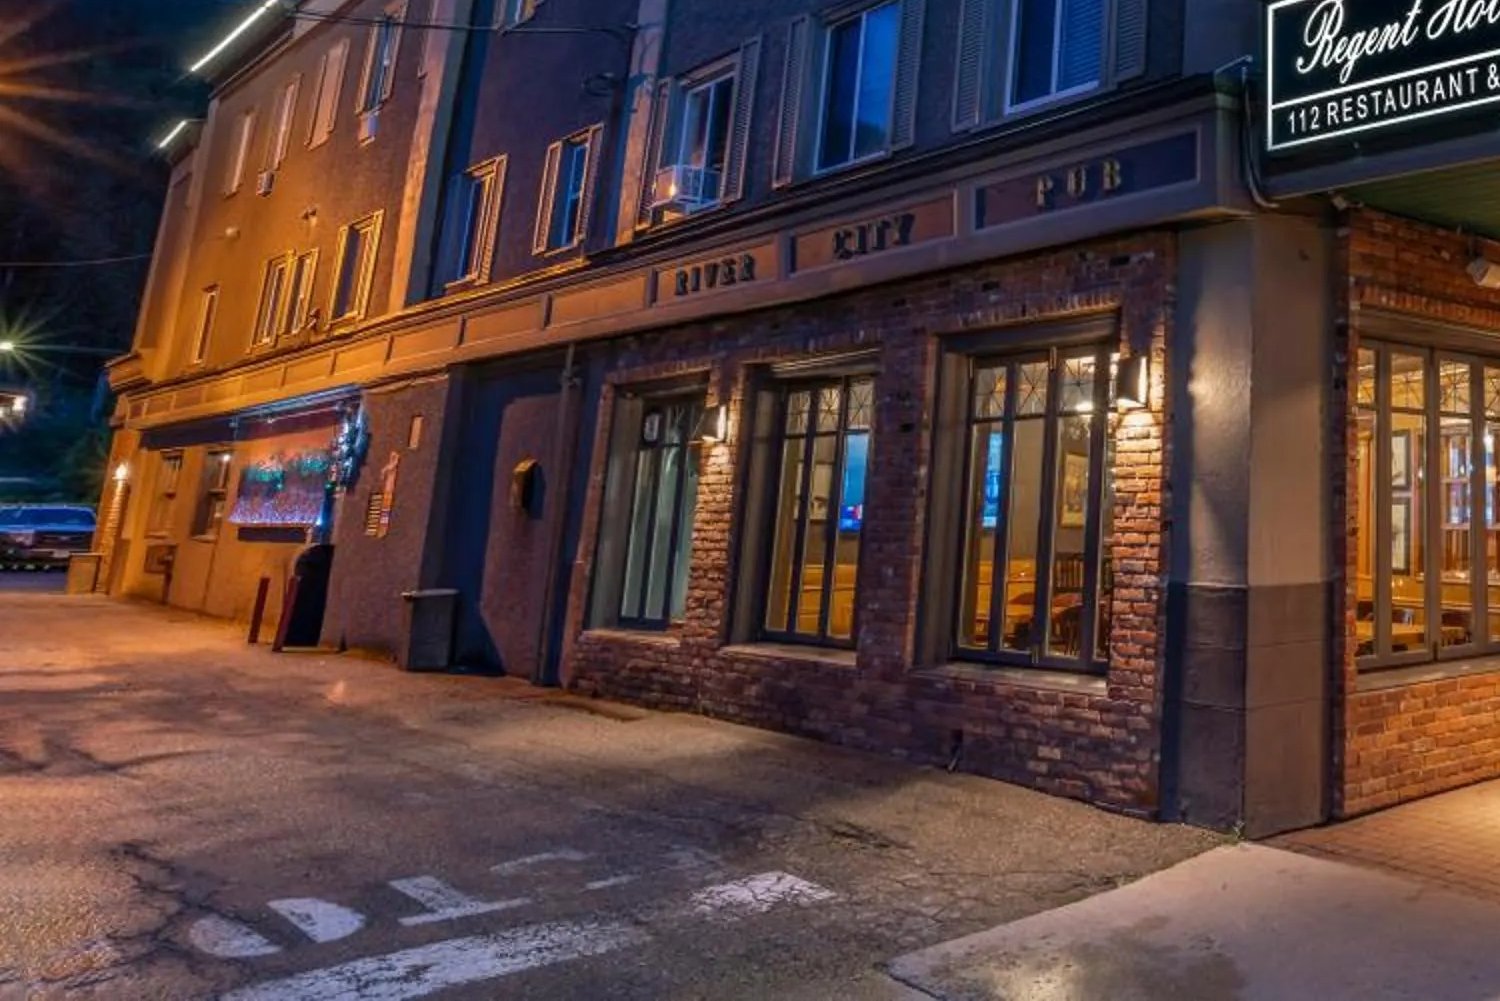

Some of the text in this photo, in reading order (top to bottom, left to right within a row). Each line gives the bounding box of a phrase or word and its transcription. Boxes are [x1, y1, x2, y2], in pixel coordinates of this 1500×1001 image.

[1288, 107, 1320, 135] 112
[1327, 68, 1479, 126] RESTAURANT
[1487, 66, 1500, 90] &
[675, 158, 1122, 296] RIVER CITY PUB
